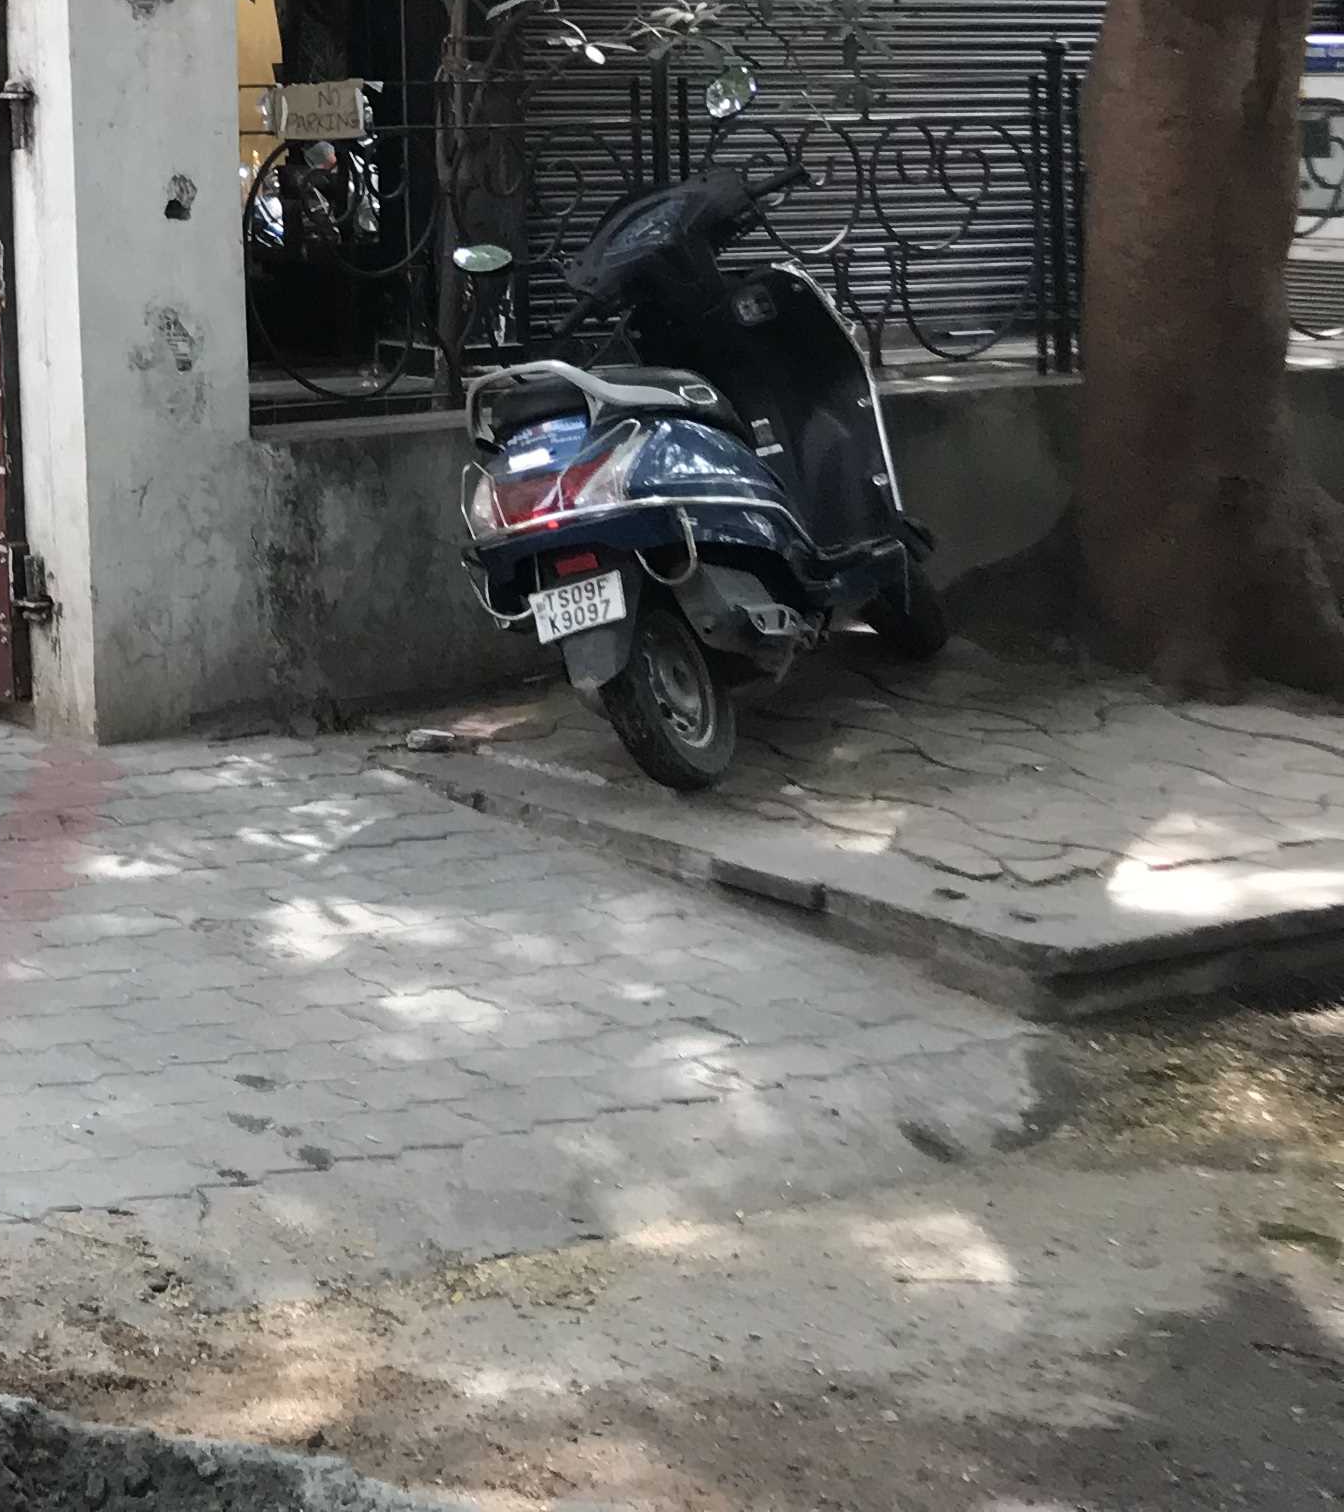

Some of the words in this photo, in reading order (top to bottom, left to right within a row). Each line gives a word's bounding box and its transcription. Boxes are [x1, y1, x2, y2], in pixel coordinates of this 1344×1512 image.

[289, 111, 359, 134] PARKING
[544, 577, 609, 613] TS09F
[548, 598, 611, 635] K9097
